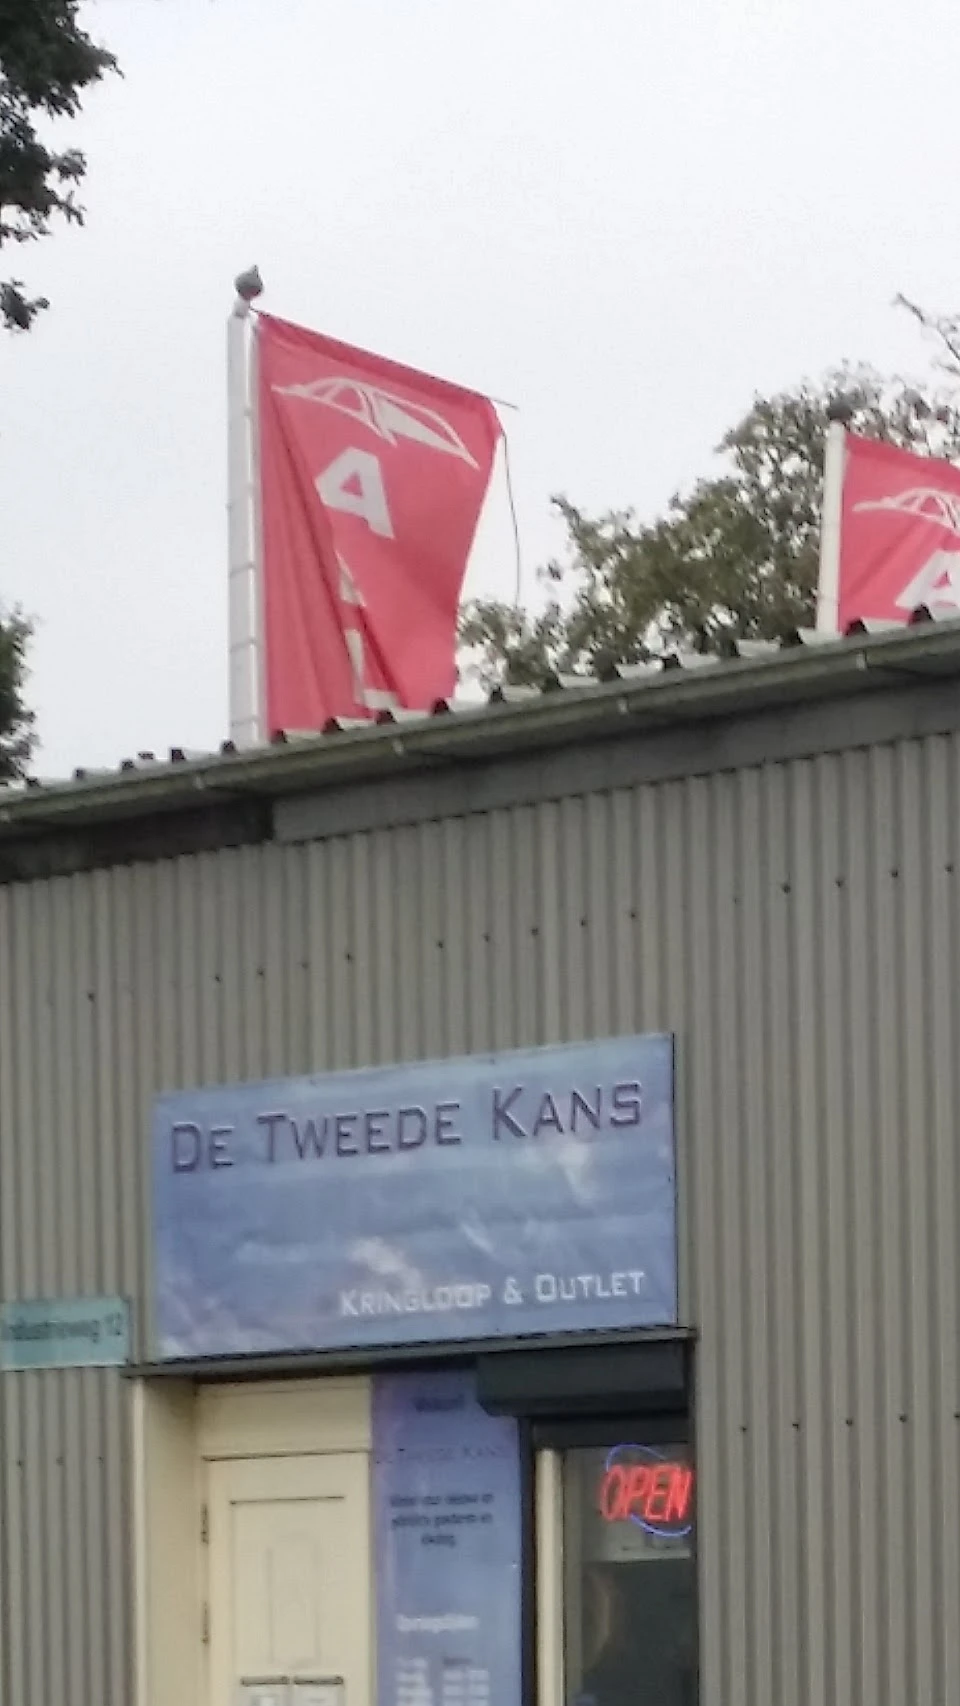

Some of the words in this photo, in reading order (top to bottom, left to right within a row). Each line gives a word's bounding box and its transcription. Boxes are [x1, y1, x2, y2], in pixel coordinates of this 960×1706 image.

[172, 1121, 235, 1174] DE
[256, 1098, 462, 1164] TWEEDE
[491, 1080, 642, 1142] KANS
[338, 1283, 493, 1317] KRINGLOOP
[503, 1276, 524, 1305] &
[534, 1270, 646, 1303] OUTLET
[600, 1464, 692, 1522] OPEN
